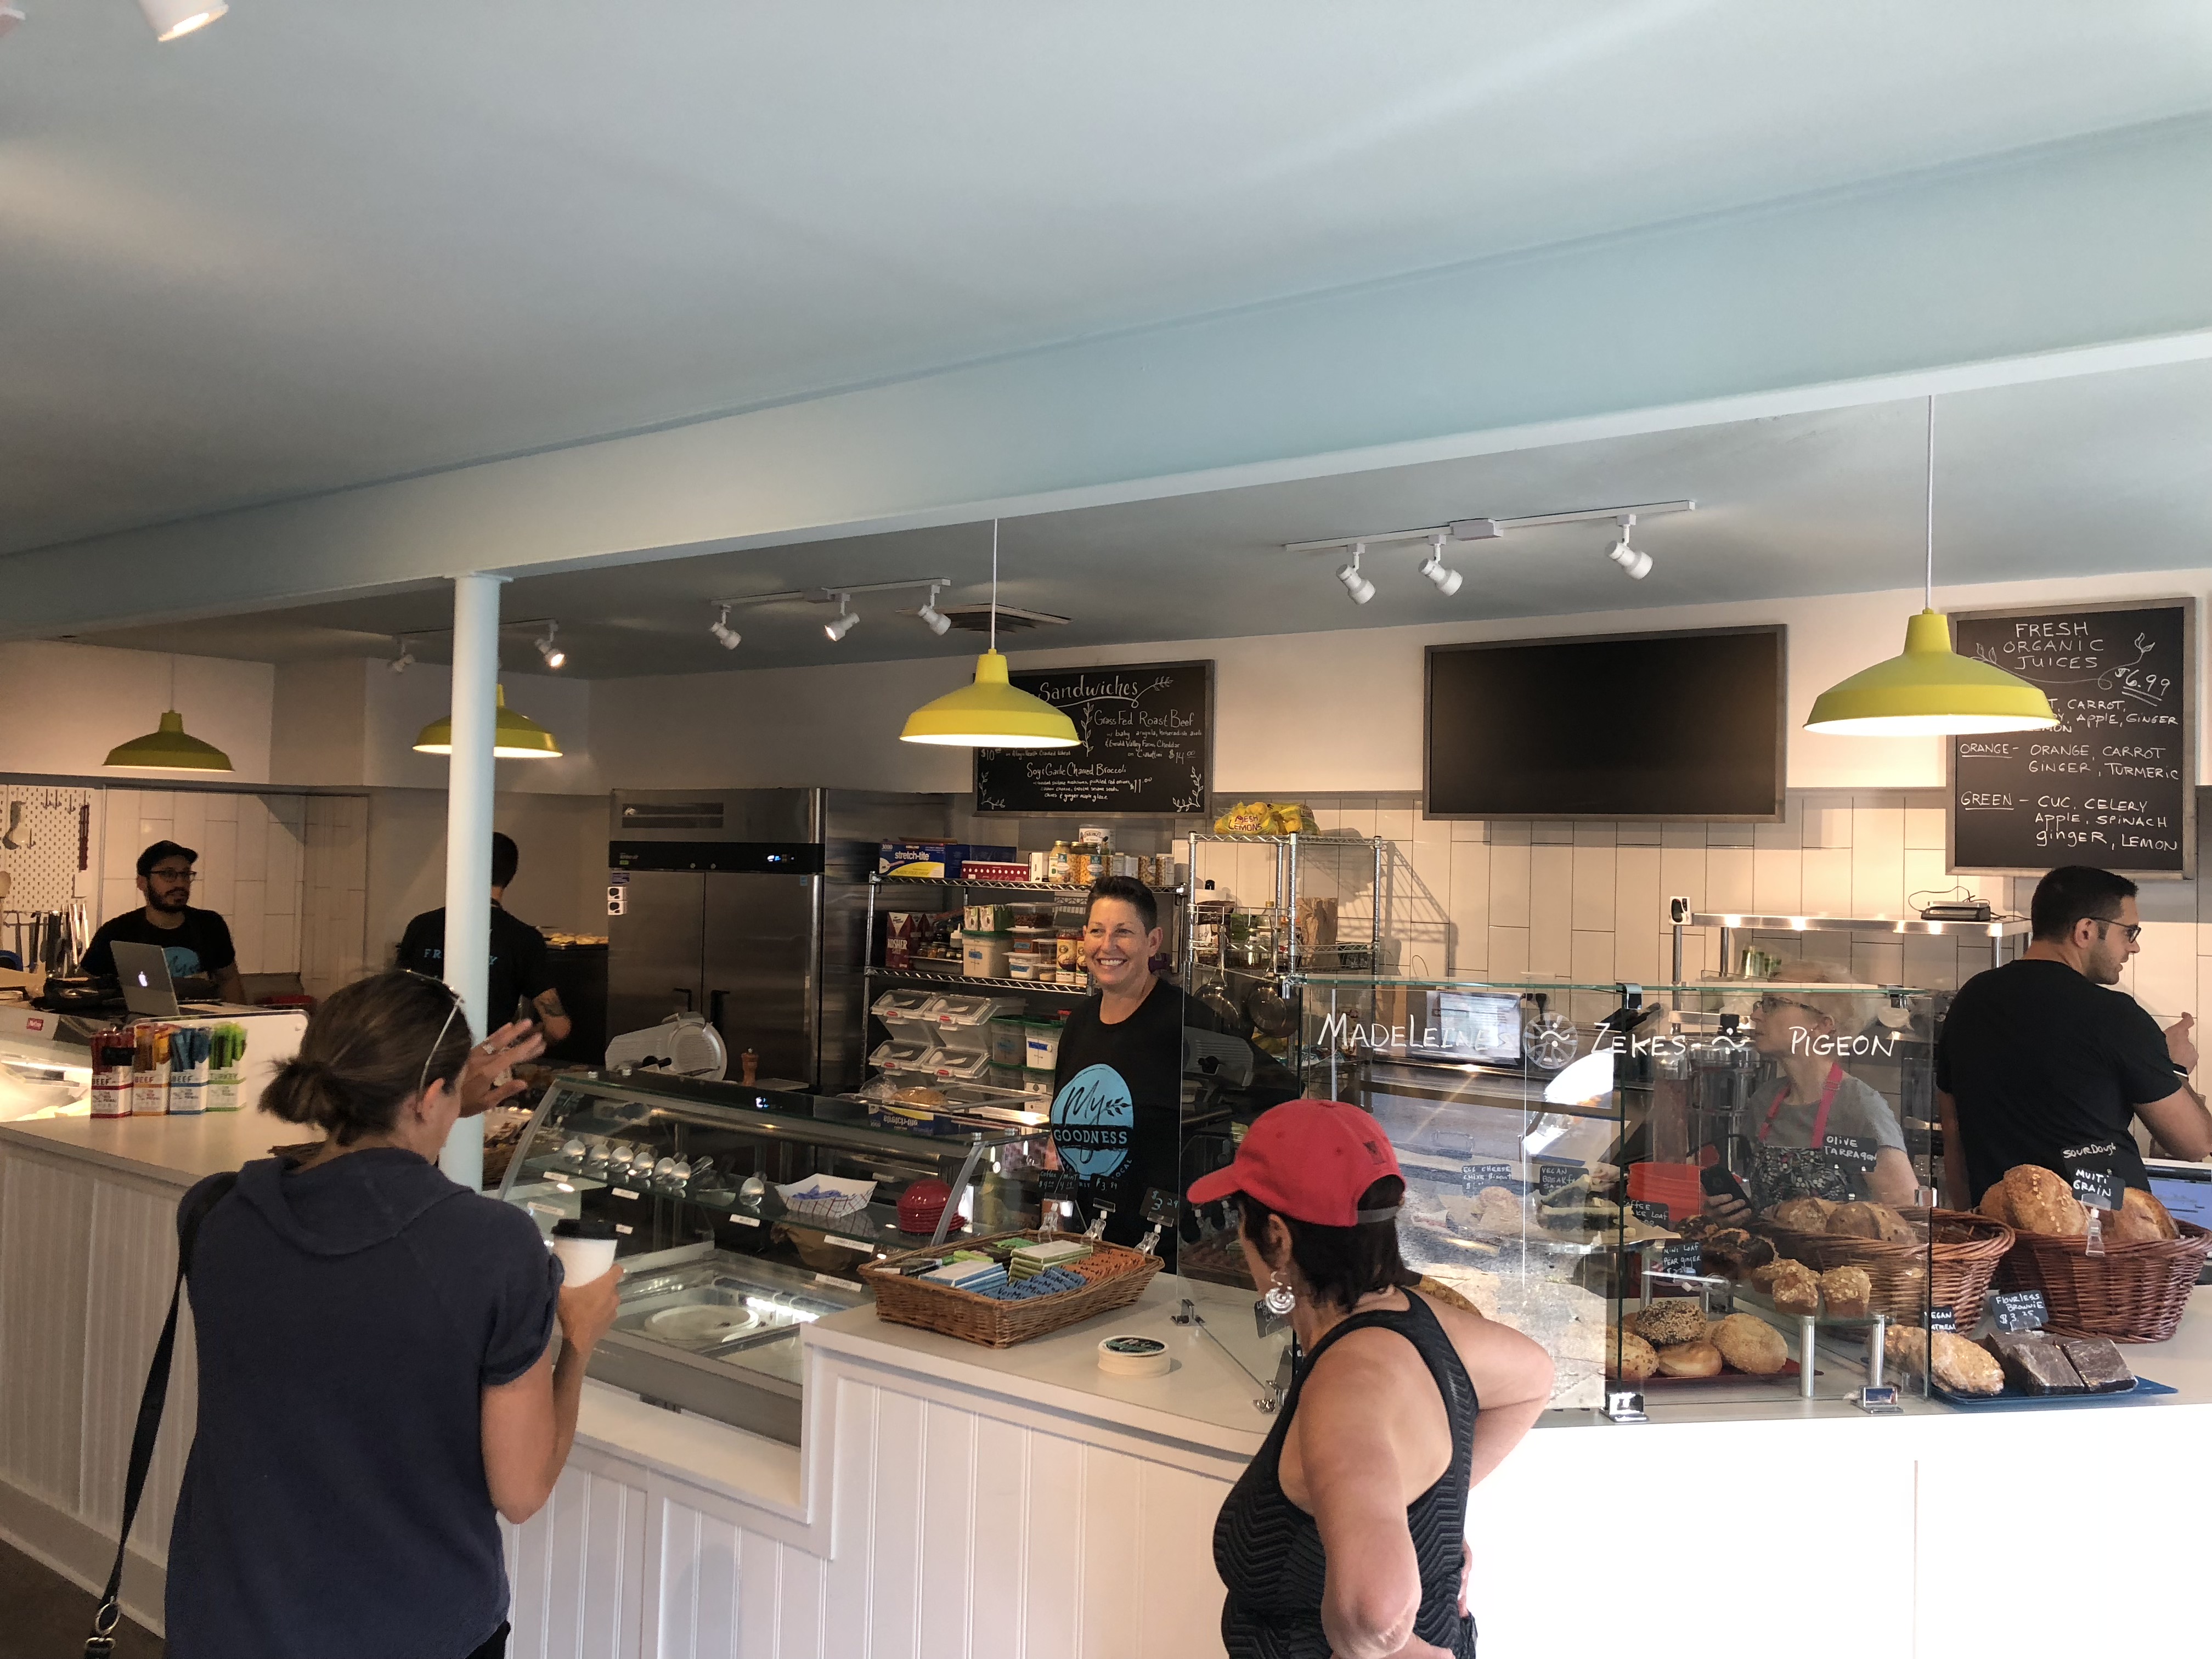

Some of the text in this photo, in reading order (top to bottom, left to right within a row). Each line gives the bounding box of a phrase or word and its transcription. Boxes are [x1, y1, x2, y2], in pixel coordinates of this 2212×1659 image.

[2016, 622, 2089, 637] FRESH
[2015, 656, 2098, 670] JUICES
[1039, 675, 1138, 702] Sandwiches
[2115, 667, 2170, 696] $6.99
[1094, 709, 1194, 727] Grass Fed Roast Beef
[1115, 729, 1130, 740] baby
[1157, 740, 1181, 748] Cheddar
[1960, 743, 2010, 755] ORANGE
[2102, 746, 2166, 760] CARROT
[1027, 763, 1041, 779] Soy
[1046, 763, 1065, 776] Garlic
[1067, 762, 1093, 776] Charred
[1097, 763, 1126, 776] Broccoli
[1960, 791, 2013, 806] GREEN
[2084, 797, 2148, 812] CELERY
[1228, 820, 1262, 832] LEMONS
[2121, 834, 2178, 851] LEMON
[895, 851, 929, 860] stretch-tite
[887, 939, 907, 950] KOSHER
[92, 1077, 109, 1086] BEEF
[135, 1075, 154, 1084] BEEF
[1062, 1080, 1105, 1126] My
[1053, 1128, 1128, 1145] GOODNESS
[1663, 1257, 1679, 1266] PEAR
